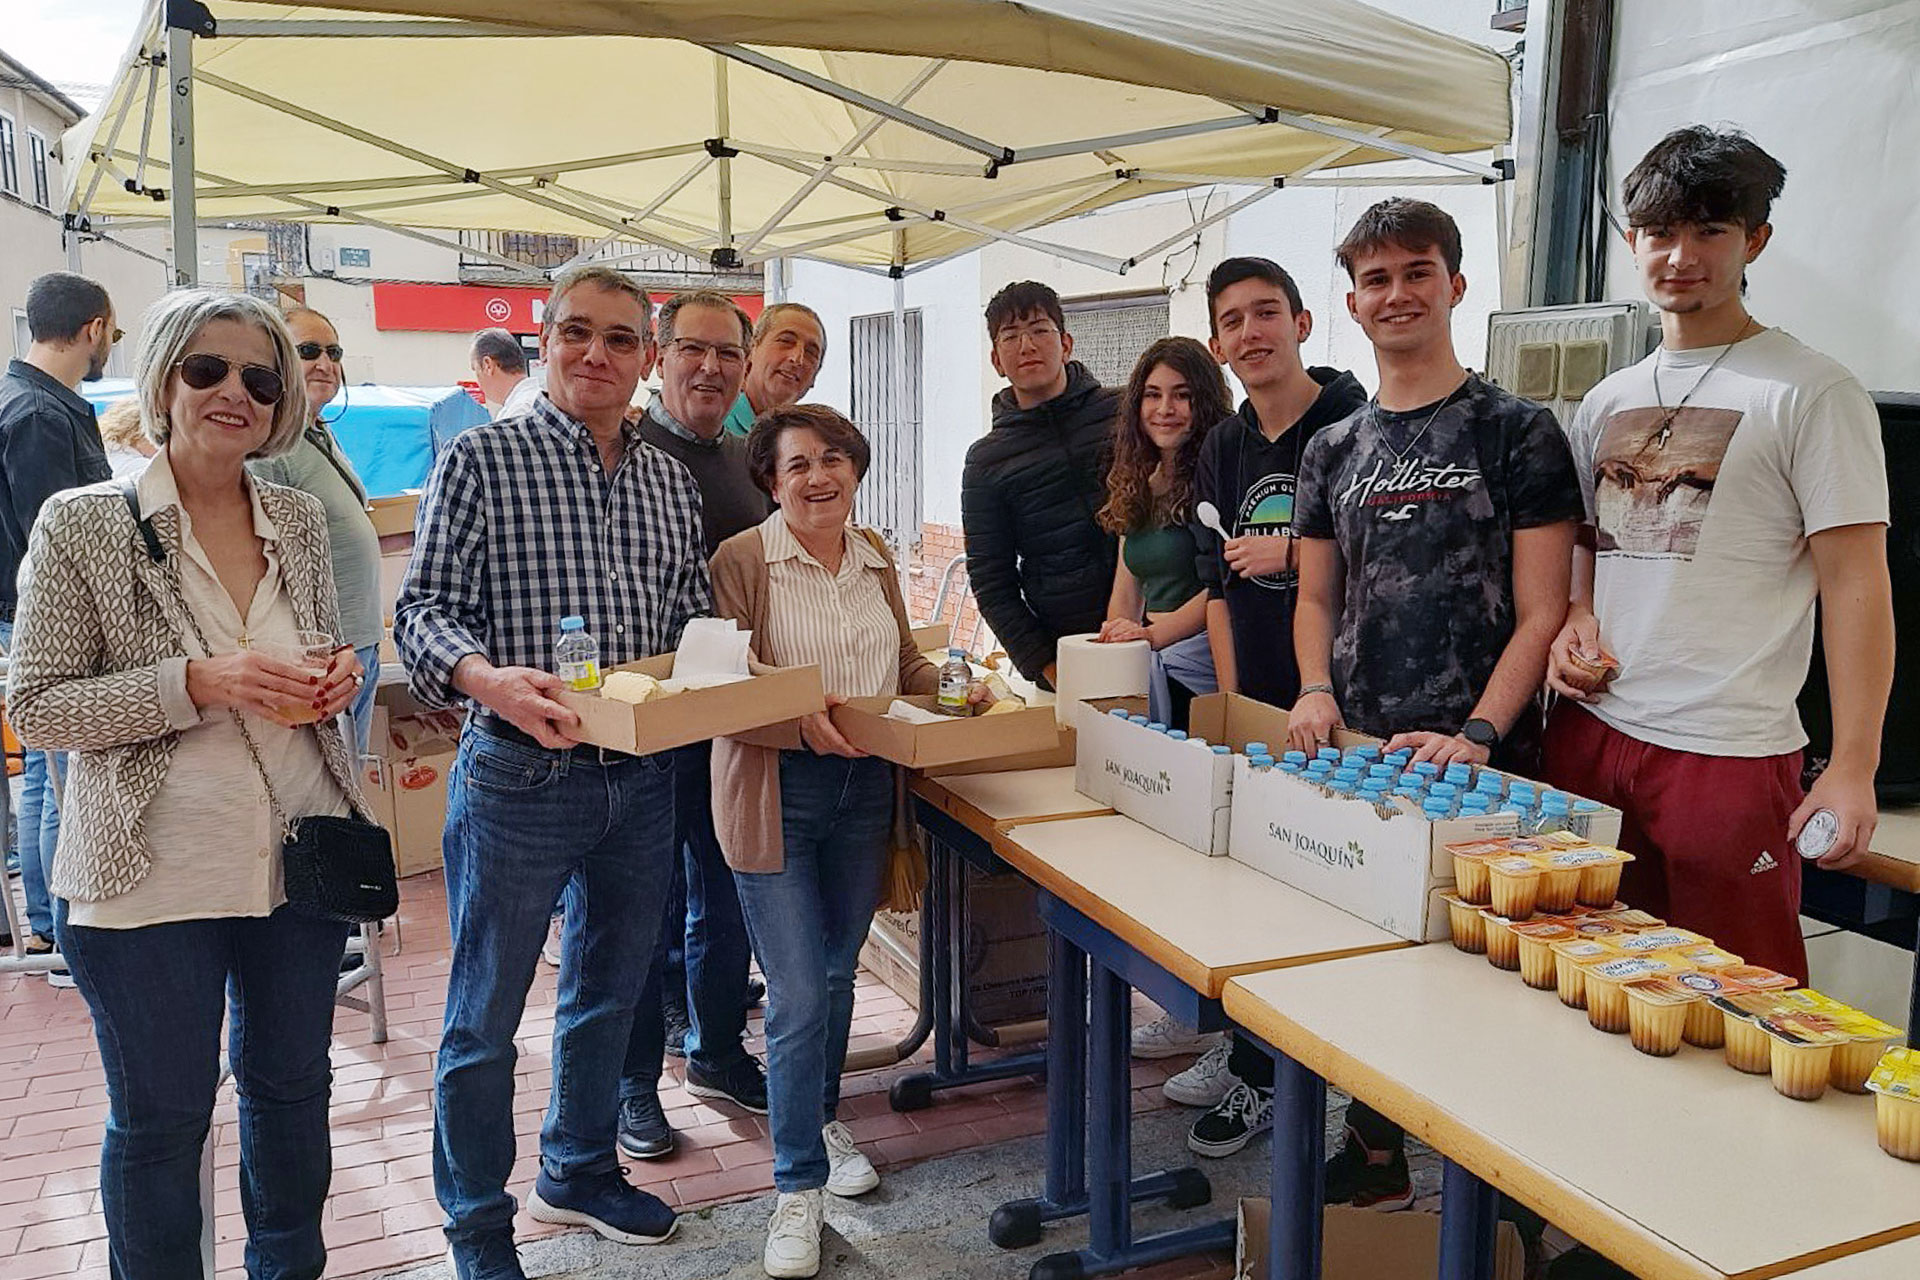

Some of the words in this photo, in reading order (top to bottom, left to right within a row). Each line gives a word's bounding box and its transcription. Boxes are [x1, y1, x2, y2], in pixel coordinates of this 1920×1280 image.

[176, 76, 189, 97] 6
[1339, 457, 1482, 508] Hollister
[1245, 484, 1277, 518] PREMIUM
[1105, 759, 1120, 776] SAN
[1268, 822, 1291, 843] SAN
[1295, 832, 1354, 869] JOAQUÍN
